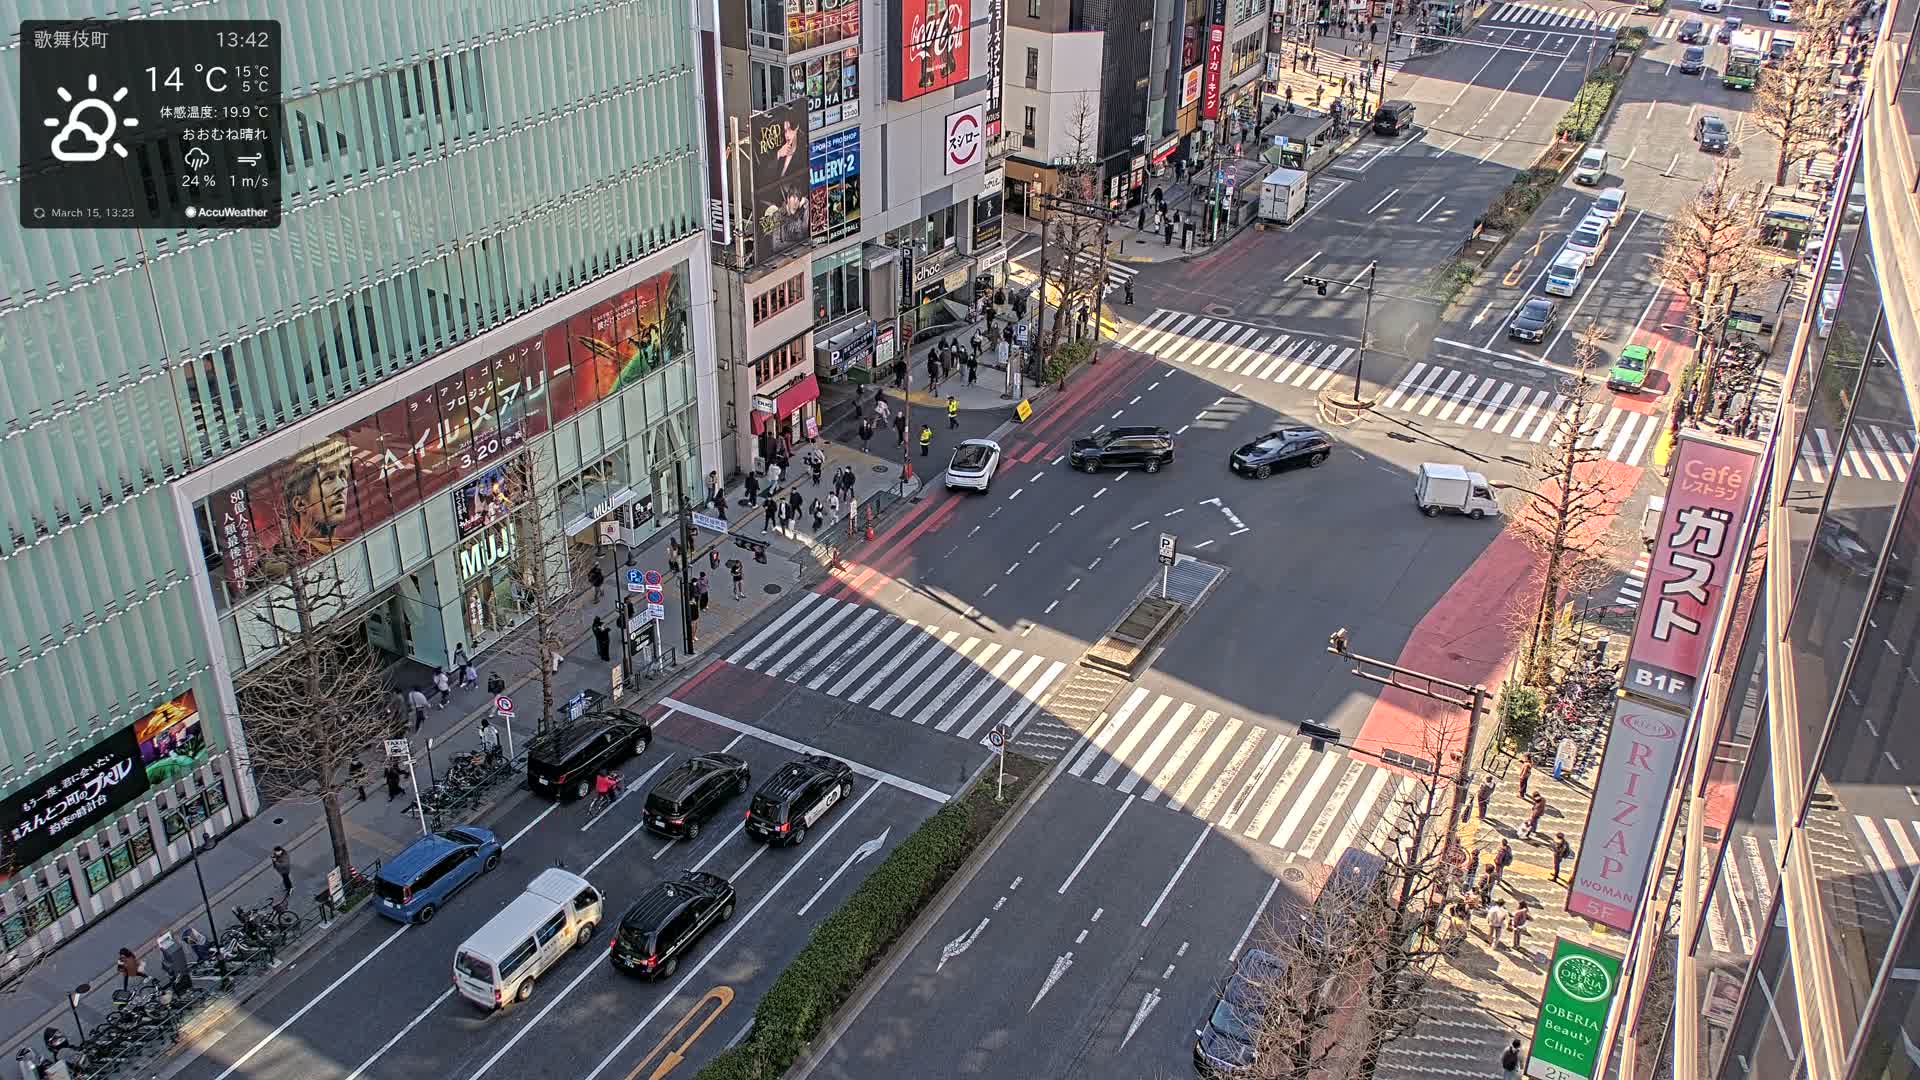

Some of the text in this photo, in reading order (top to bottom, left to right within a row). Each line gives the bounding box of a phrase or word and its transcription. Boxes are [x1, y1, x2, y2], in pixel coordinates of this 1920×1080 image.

[1207, 44, 1221, 109] バーガーキング
[843, 132, 857, 142] SHOP
[949, 131, 981, 150] スシロー
[711, 199, 723, 233] MUJI
[903, 249, 911, 258] P
[1019, 325, 1027, 334] P
[831, 350, 840, 366] P
[410, 340, 542, 412] ライアン・ゴスリング
[447, 377, 504, 411] プロジェクト
[461, 439, 499, 469] 3.20
[1684, 459, 1743, 488] Café
[1681, 479, 1738, 501] レストラン
[593, 495, 616, 520] MUJI
[460, 521, 517, 581] MUJI
[1162, 539, 1170, 548] P
[1653, 507, 1733, 642] ガスト
[1634, 668, 1685, 694] B1F
[1600, 740, 1655, 880] RIZAP
[1580, 879, 1634, 903] WOMAN
[1586, 901, 1616, 918] 5F
[1561, 969, 1602, 991] OBERIA
[1545, 1003, 1600, 1031] OBERIA
[1545, 1019, 1592, 1046] Beauty
[1544, 1038, 1585, 1061] Clinic
[1545, 1066, 1570, 1080] 2F
